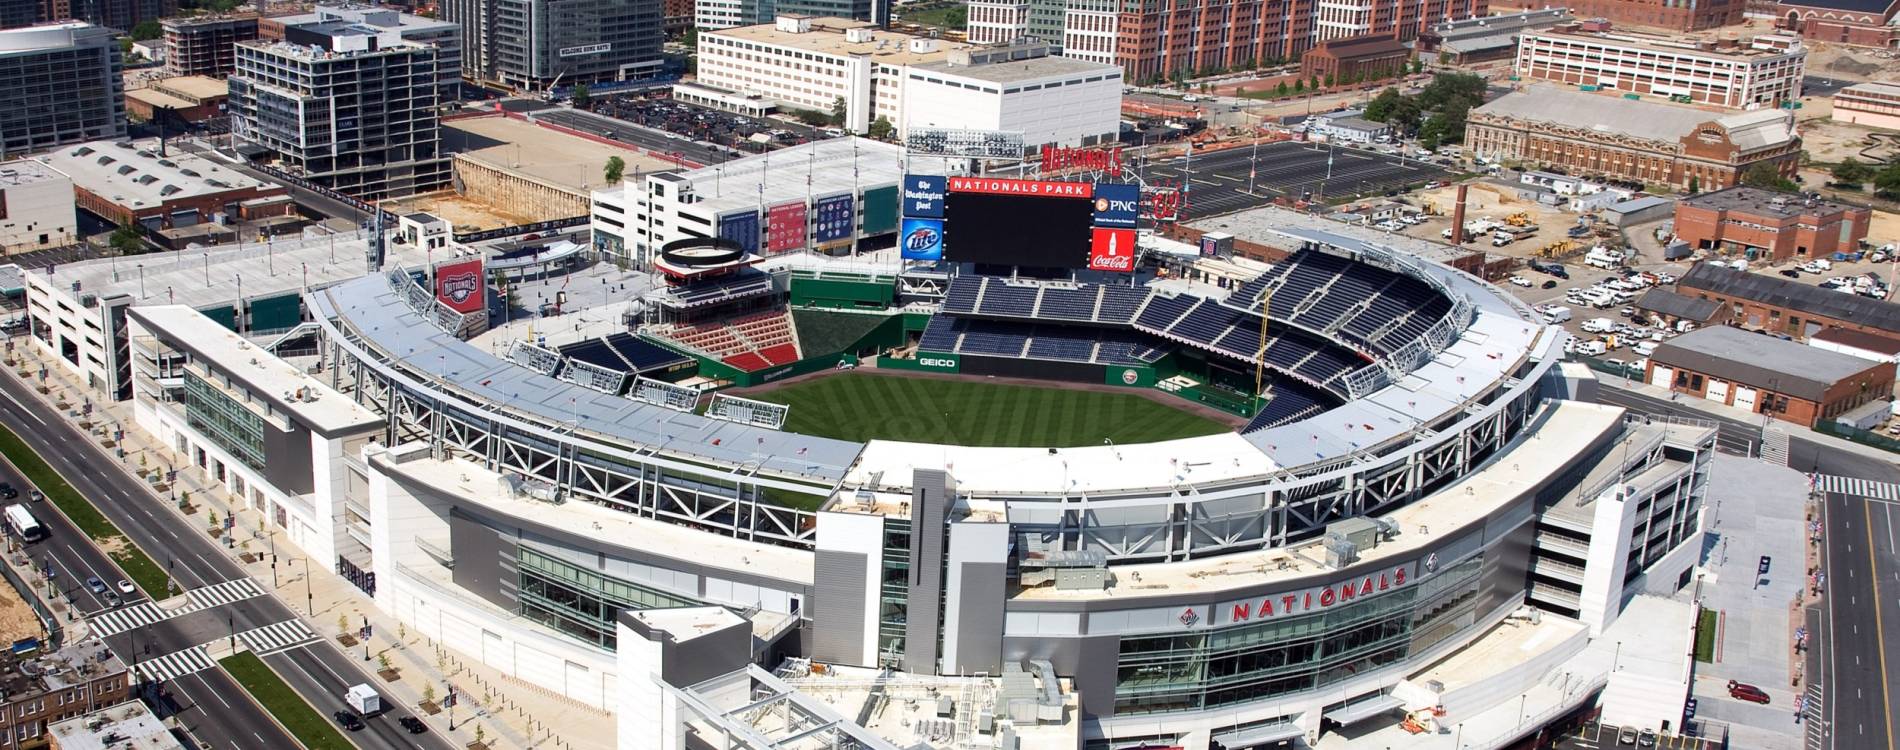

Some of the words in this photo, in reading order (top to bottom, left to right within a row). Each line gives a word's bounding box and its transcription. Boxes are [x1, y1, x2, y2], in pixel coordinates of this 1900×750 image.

[1042, 144, 1121, 176] NATIONALS
[918, 180, 931, 190] The
[953, 179, 1039, 193] NATIONALS
[1045, 184, 1084, 195] PARK
[905, 189, 943, 201] Washington
[916, 201, 931, 211] Post
[1110, 200, 1137, 212] PNC
[910, 233, 937, 250] Lite
[444, 277, 476, 295] NATIONALS
[920, 357, 955, 368] GEICO
[1231, 567, 1406, 622] NATIONALS
